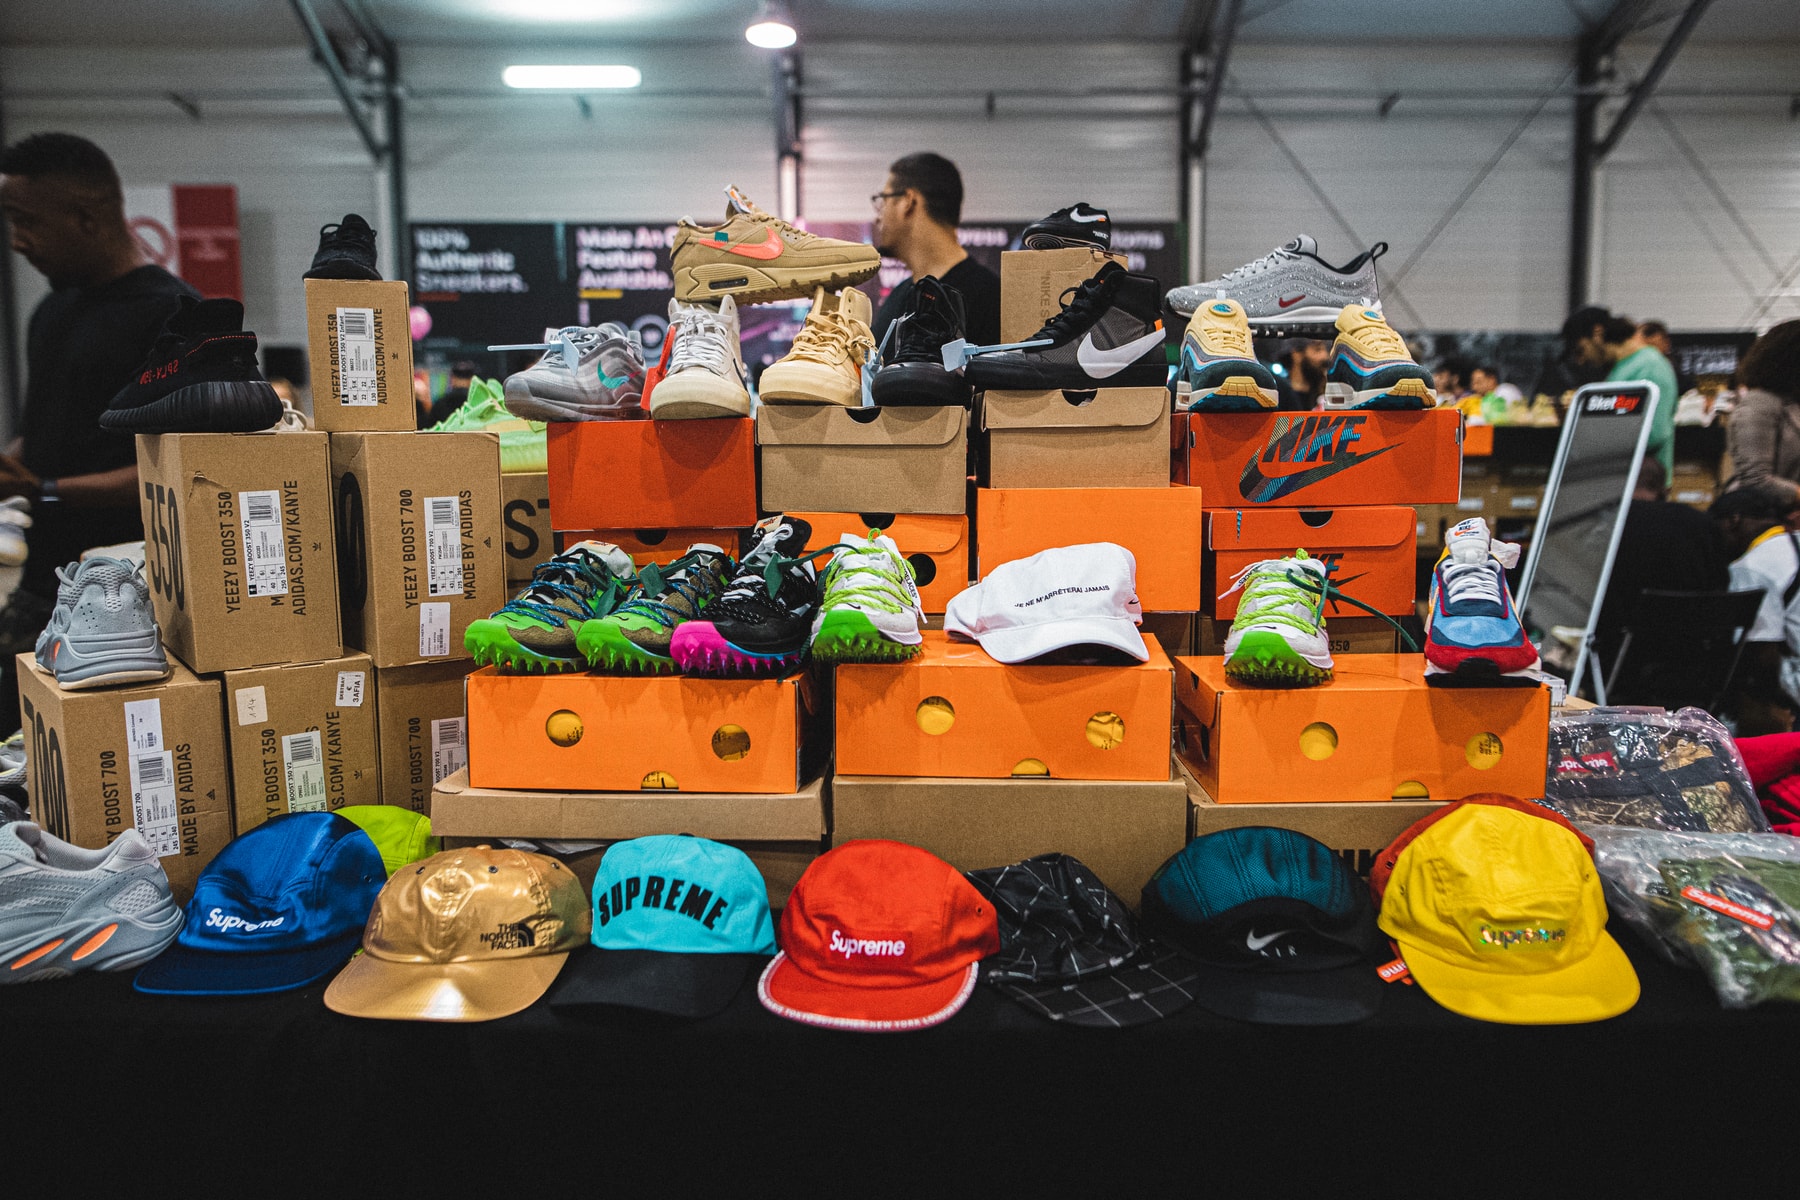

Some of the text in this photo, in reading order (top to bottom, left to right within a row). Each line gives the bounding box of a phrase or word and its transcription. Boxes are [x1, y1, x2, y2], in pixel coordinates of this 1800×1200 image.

[576, 227, 632, 249] Make
[416, 250, 515, 271] Authentic
[578, 250, 656, 270] Feature
[418, 272, 529, 292] Sneakers.
[328, 314, 337, 332] 350
[329, 335, 339, 365] BOOST
[375, 308, 387, 404] ADIDAS.COM/KANYE
[1262, 416, 1367, 462] NIKE
[244, 520, 250, 528] V2
[145, 482, 185, 611] 350
[218, 492, 240, 614] YEEZY BOOST 350
[284, 480, 306, 616] ADIDAS.COM/KANYE
[399, 489, 418, 608] YEEZY BOOST 700
[460, 490, 476, 599] MADE BY ADIDAS
[1025, 598, 1035, 607] NE
[1085, 584, 1110, 593] JAMAIS
[353, 681, 361, 702] 3AFIA
[261, 729, 276, 754] 350
[408, 717, 421, 742] 700
[23, 694, 71, 842] 700
[100, 751, 117, 778] 700
[409, 744, 422, 784] BOOST
[263, 759, 280, 801] BOOST
[103, 782, 121, 826] BOOST
[176, 743, 199, 856] MADE BY ADIDAS
[599, 875, 728, 931] SUPREME
[1687, 889, 1770, 926] Supreme
[205, 907, 284, 932] Supreme
[498, 922, 519, 933] THE
[480, 930, 519, 942] NORTH
[490, 940, 519, 950] FACE
[829, 929, 905, 959] Supreme
[869, 1020, 892, 1030] NEW
[894, 1019, 921, 1029] YORK
